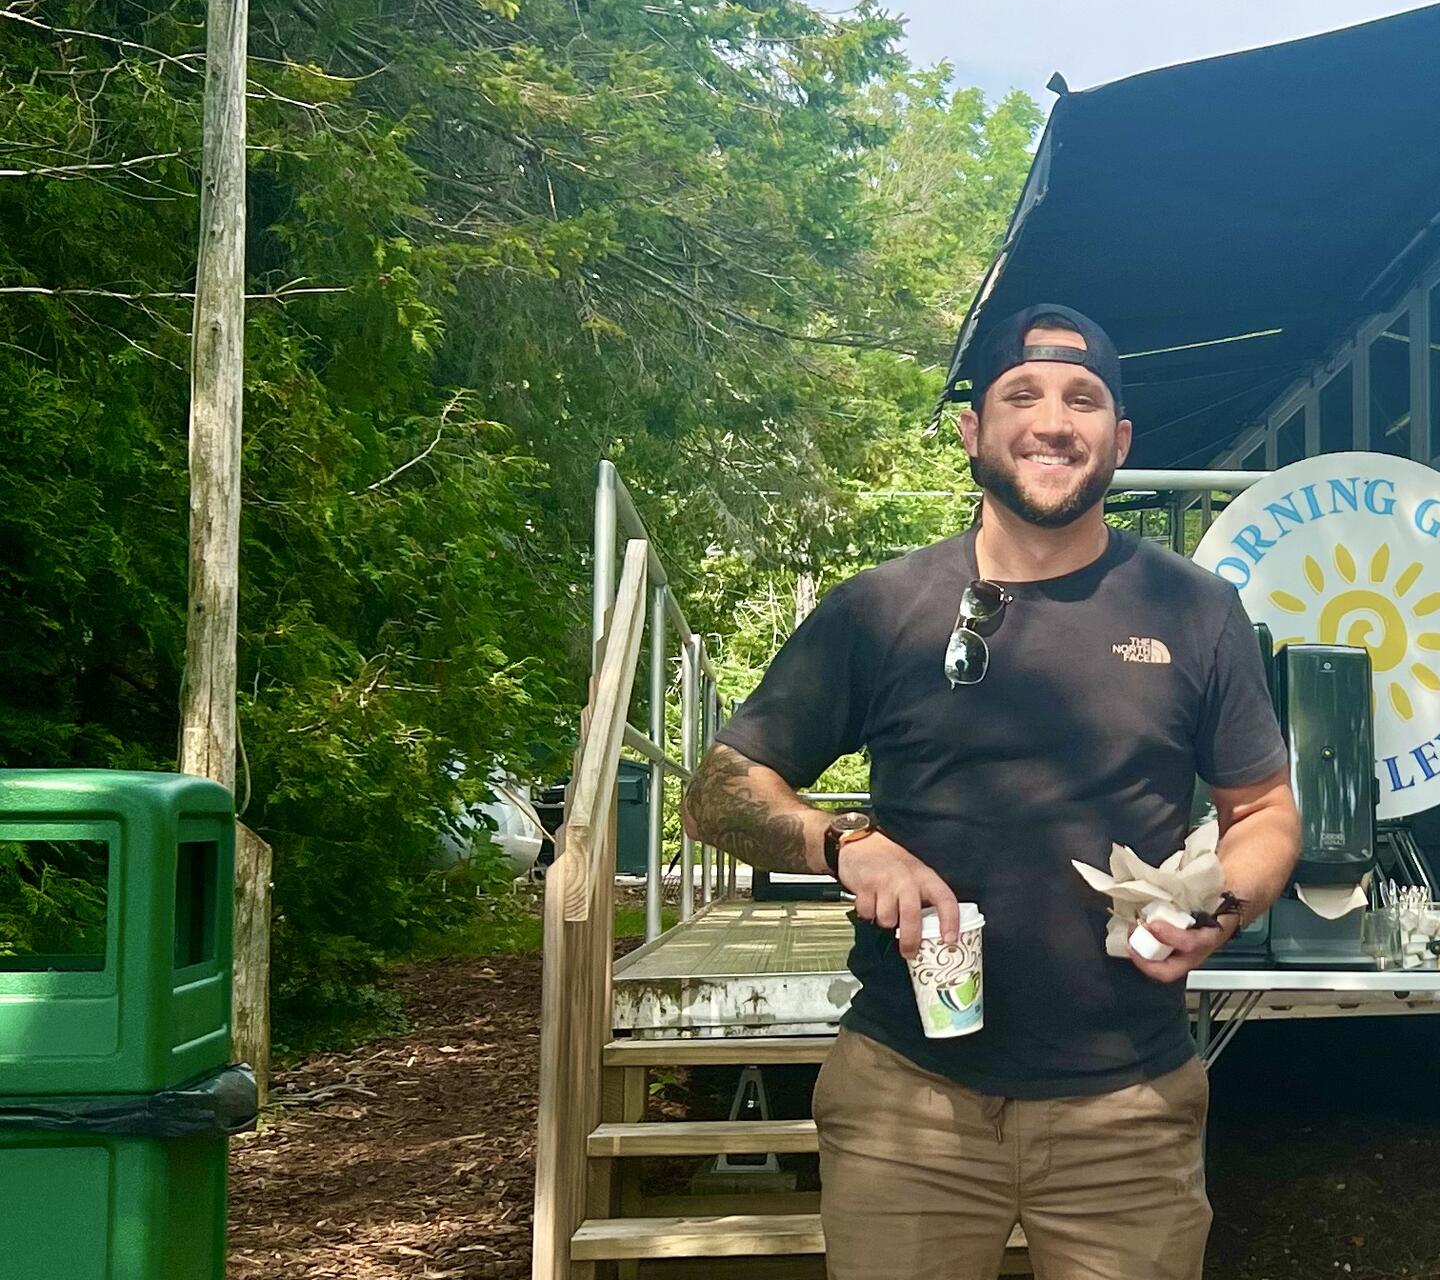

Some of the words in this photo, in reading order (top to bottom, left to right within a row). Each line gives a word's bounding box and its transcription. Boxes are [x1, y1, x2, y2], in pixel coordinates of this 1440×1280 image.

[1214, 476, 1398, 591] ORNING
[1129, 636, 1150, 646] THE
[1112, 644, 1150, 655] NORTH
[1123, 653, 1150, 663] FACE
